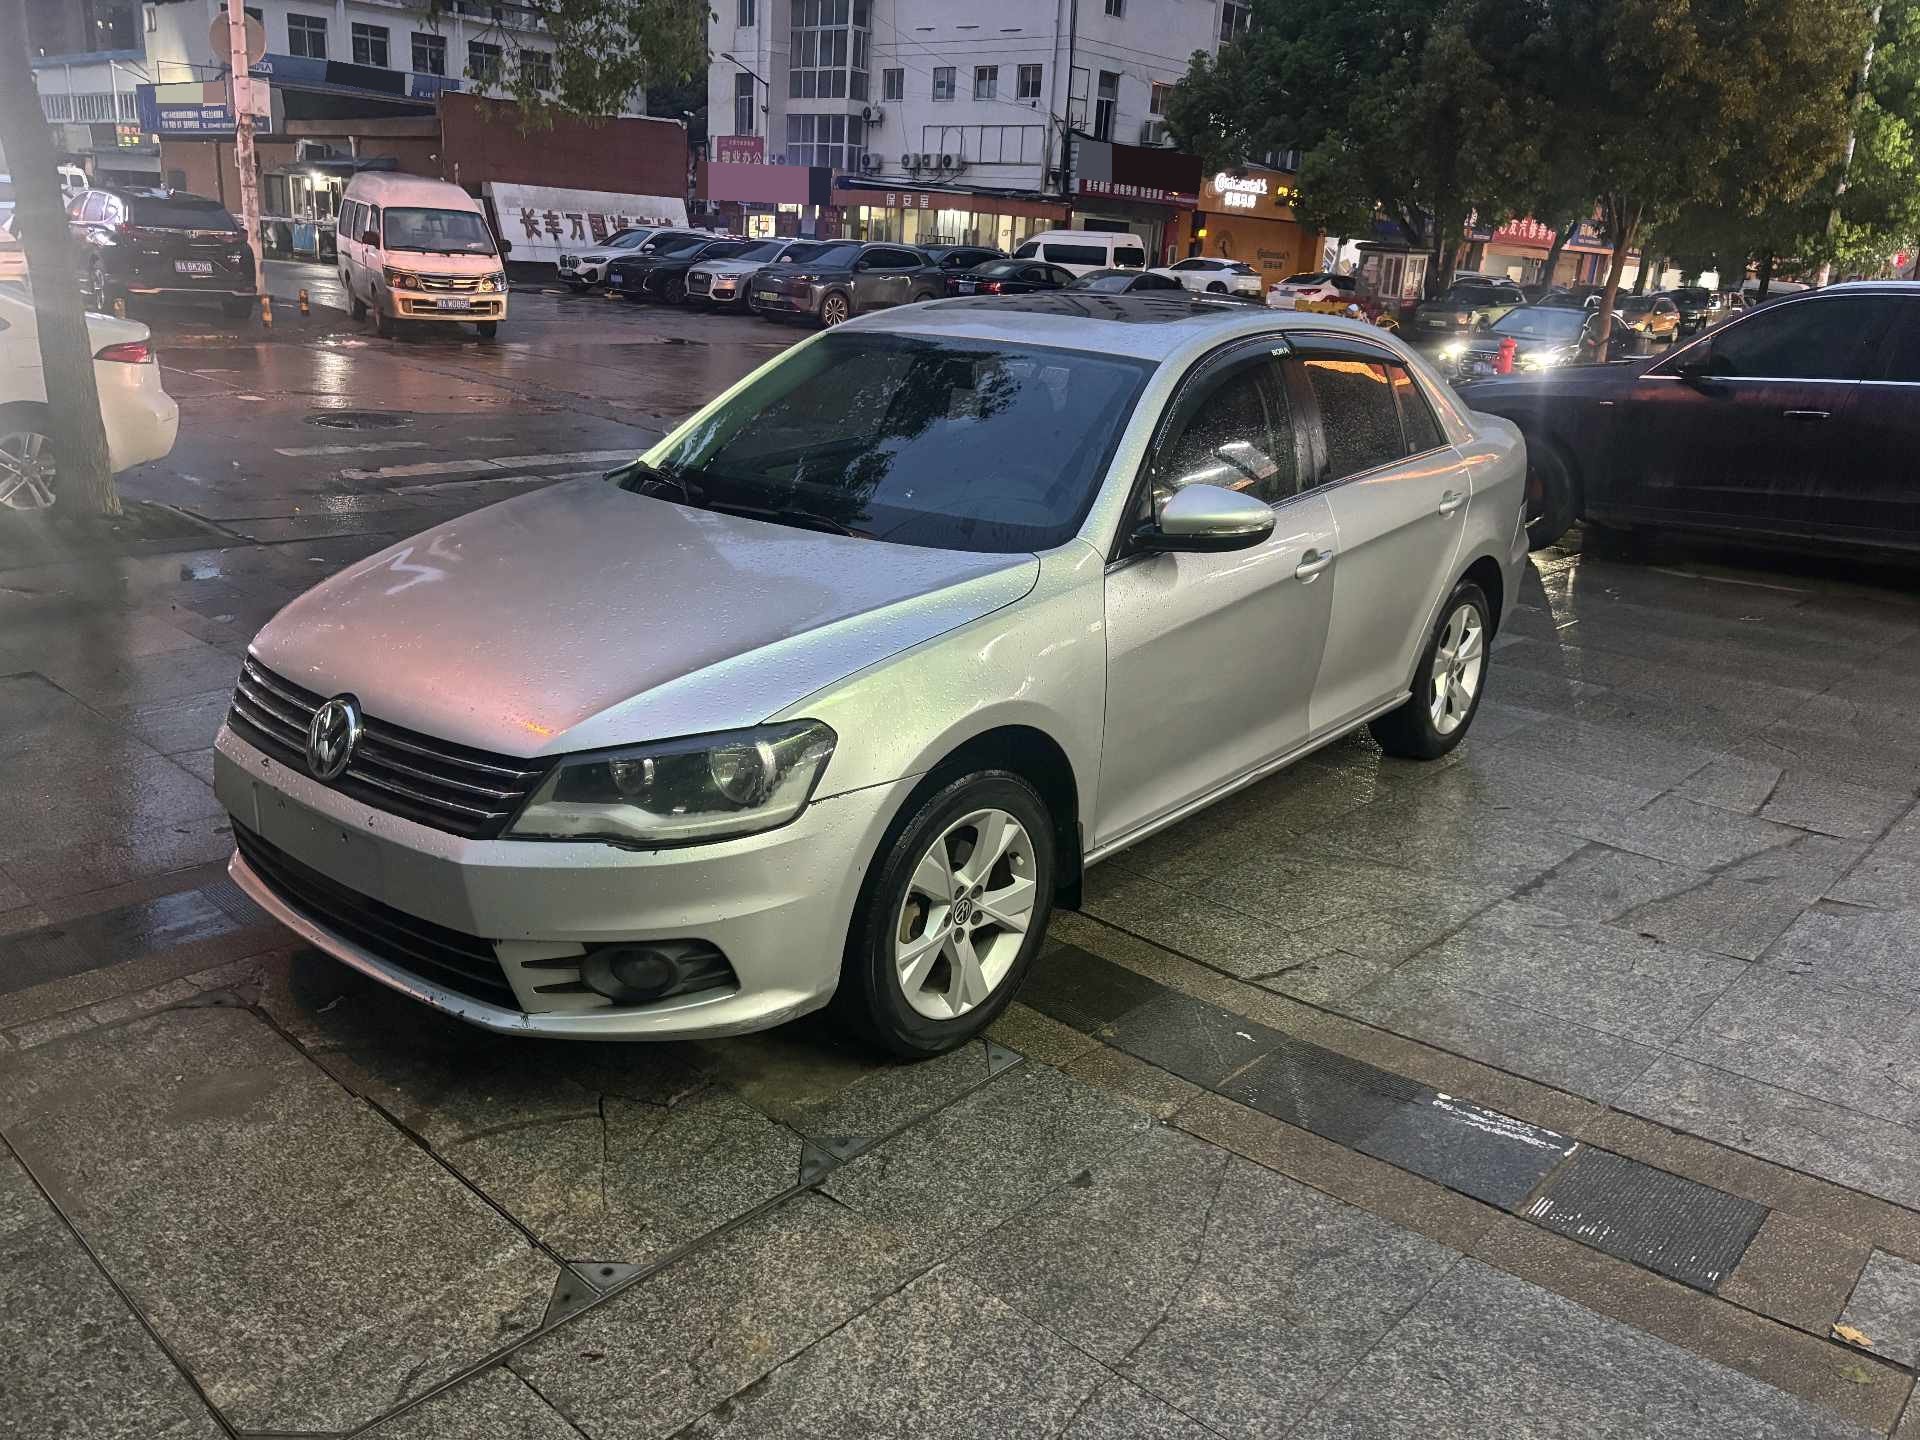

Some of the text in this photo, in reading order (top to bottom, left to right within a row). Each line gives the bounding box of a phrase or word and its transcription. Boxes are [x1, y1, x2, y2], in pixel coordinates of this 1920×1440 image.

[886, 193, 929, 208] 保安室
[1271, 347, 1290, 356] BORA
